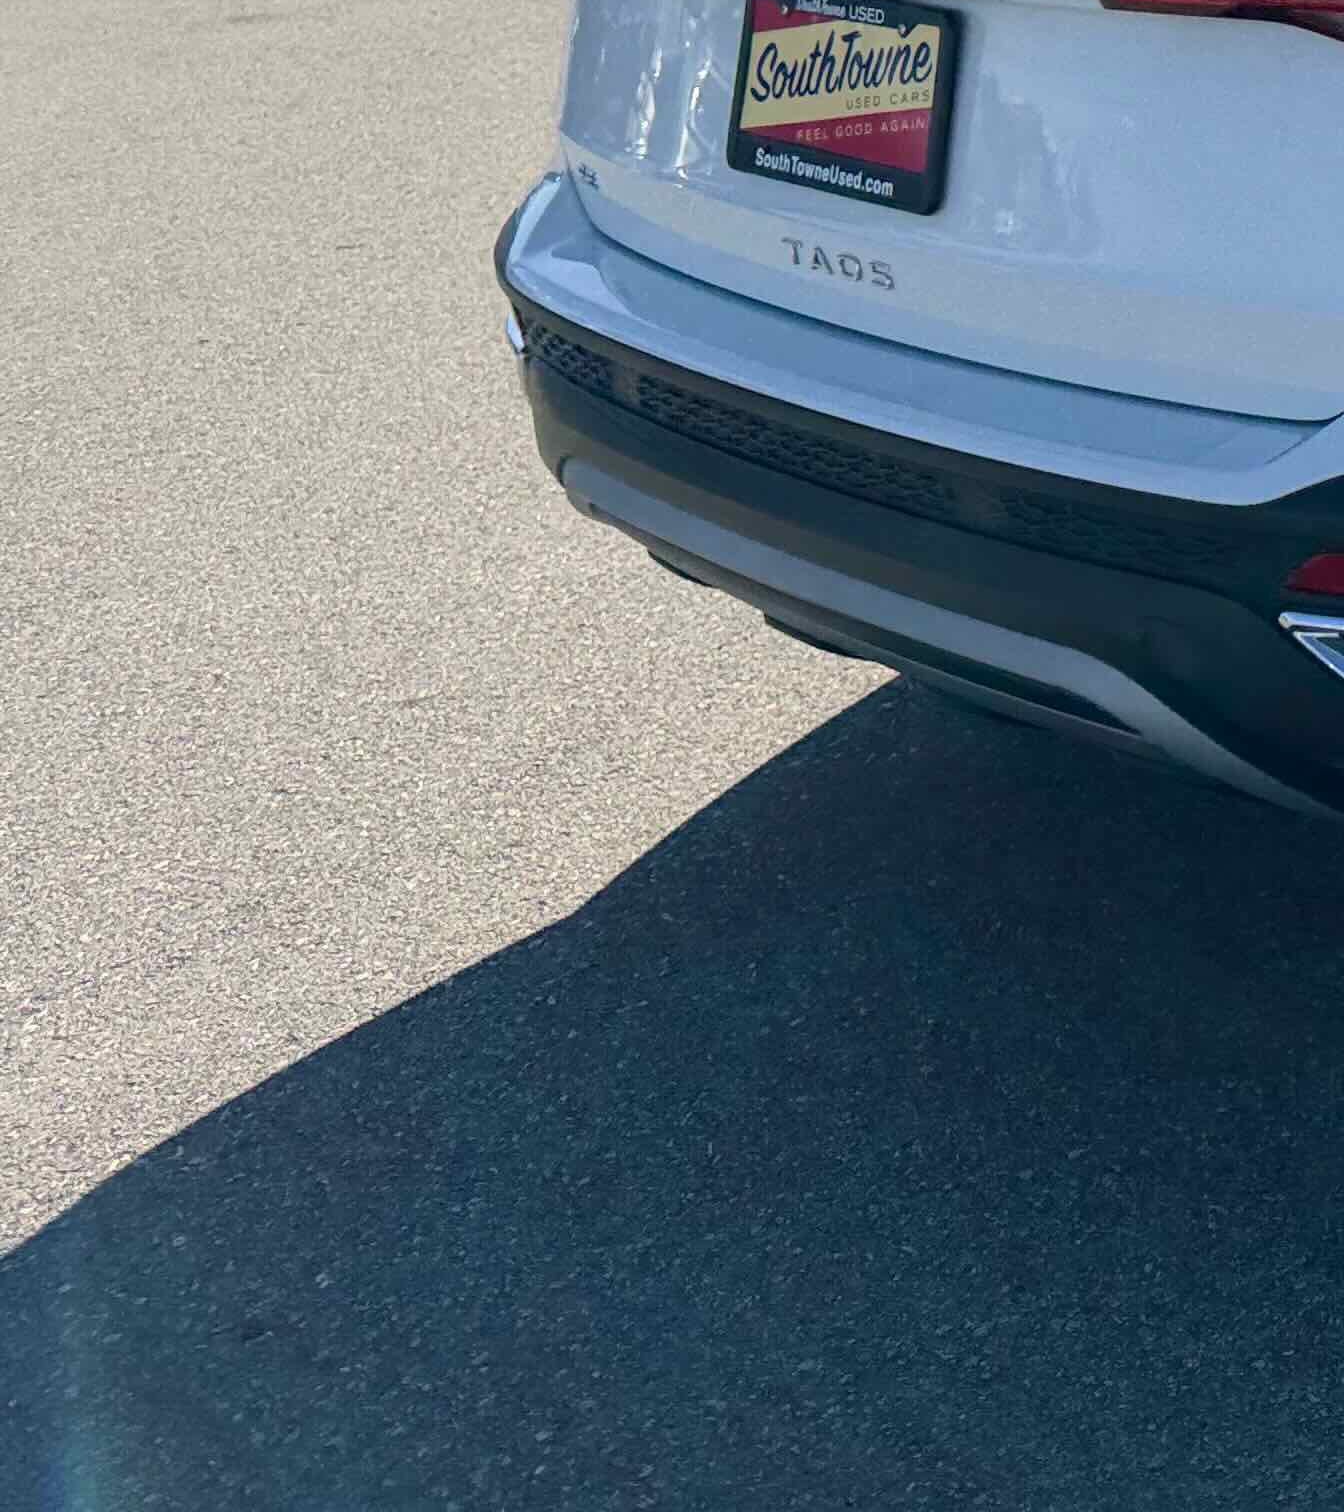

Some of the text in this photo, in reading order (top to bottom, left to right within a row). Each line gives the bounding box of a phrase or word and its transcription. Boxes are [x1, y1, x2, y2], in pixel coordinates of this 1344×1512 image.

[849, 4, 885, 25] USED
[750, 29, 932, 103] SouthTowne
[846, 89, 930, 110] USED CARS
[796, 127, 828, 141] FEEL
[835, 121, 873, 137] GOOD
[755, 147, 894, 197] SouthTowneUsed.com
[781, 237, 897, 290] TAOS
